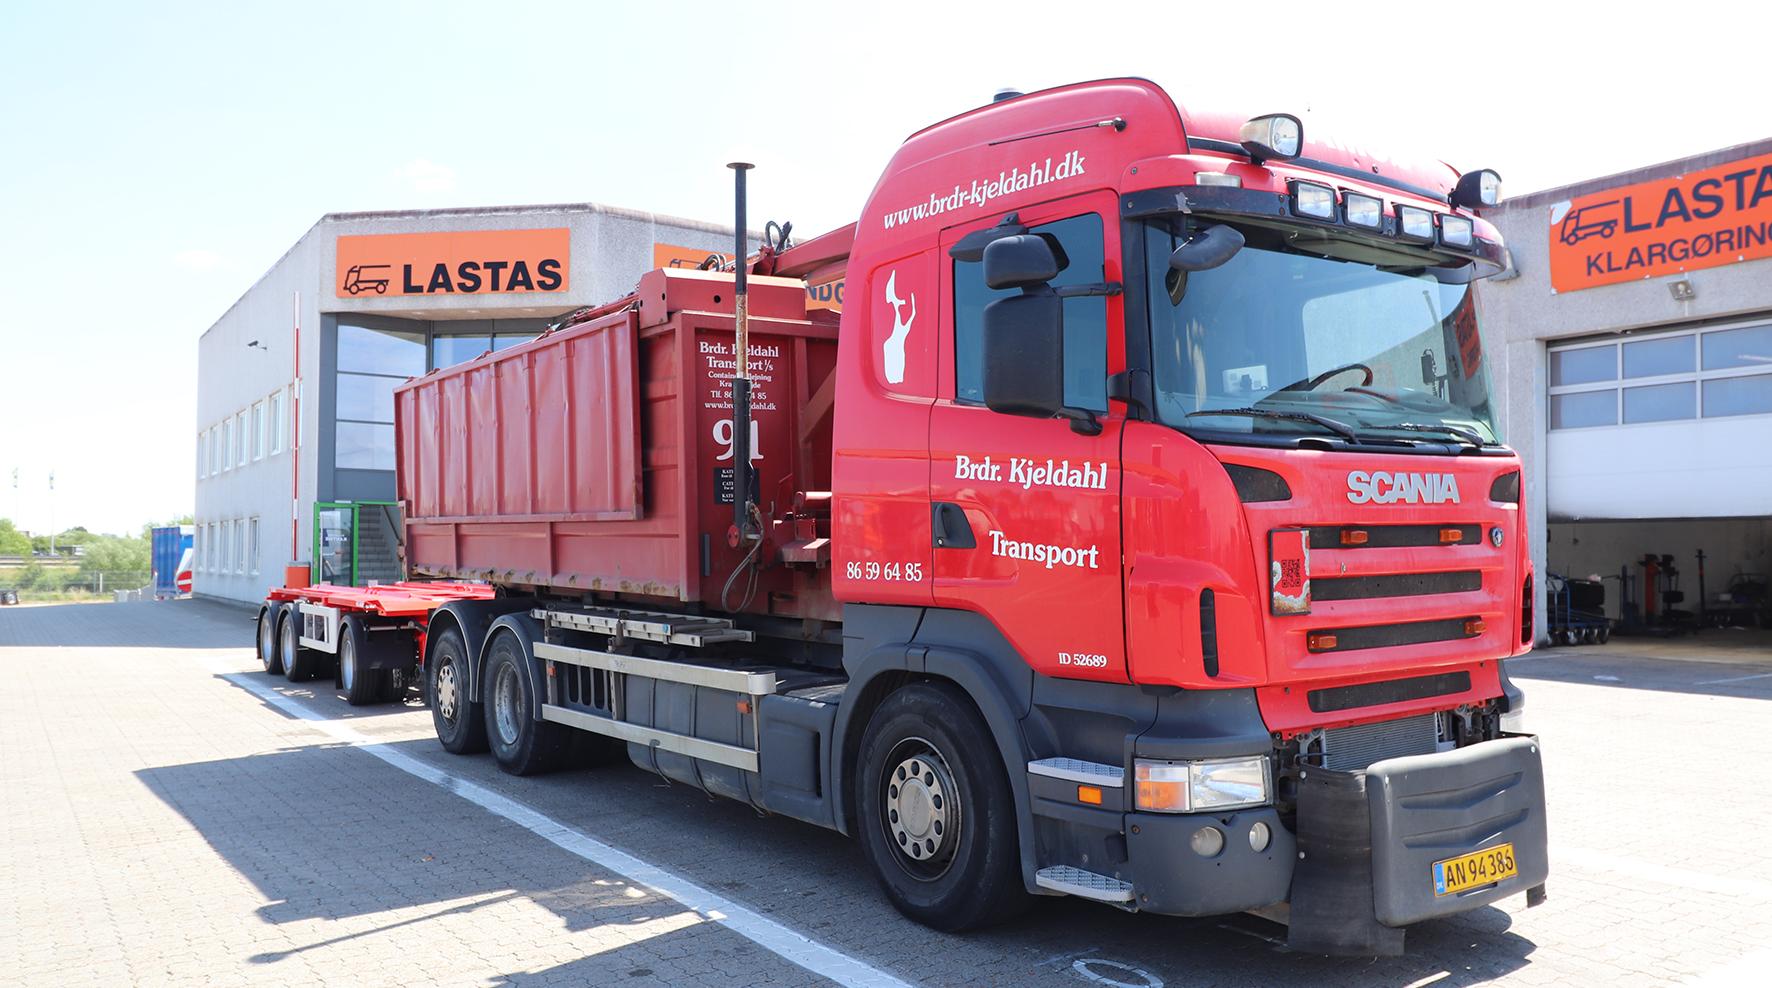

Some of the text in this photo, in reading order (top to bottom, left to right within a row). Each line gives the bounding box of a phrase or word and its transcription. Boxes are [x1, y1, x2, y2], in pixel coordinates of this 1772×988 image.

[883, 150, 1086, 230] www.brdr-kjeldahl.dk
[402, 259, 562, 293] LASTAS
[699, 341, 729, 354] Brdr.
[706, 356, 763, 371] Transort
[757, 392, 767, 400] 85
[712, 418, 764, 461] 91
[954, 455, 1107, 490] Brdr. Kjeldahl
[1346, 470, 1460, 505] SCANIA
[988, 530, 1099, 569] Transport
[846, 561, 922, 582] 86 59 64 85
[1058, 652, 1107, 667] ID 52689
[1446, 862, 1466, 888] AN
